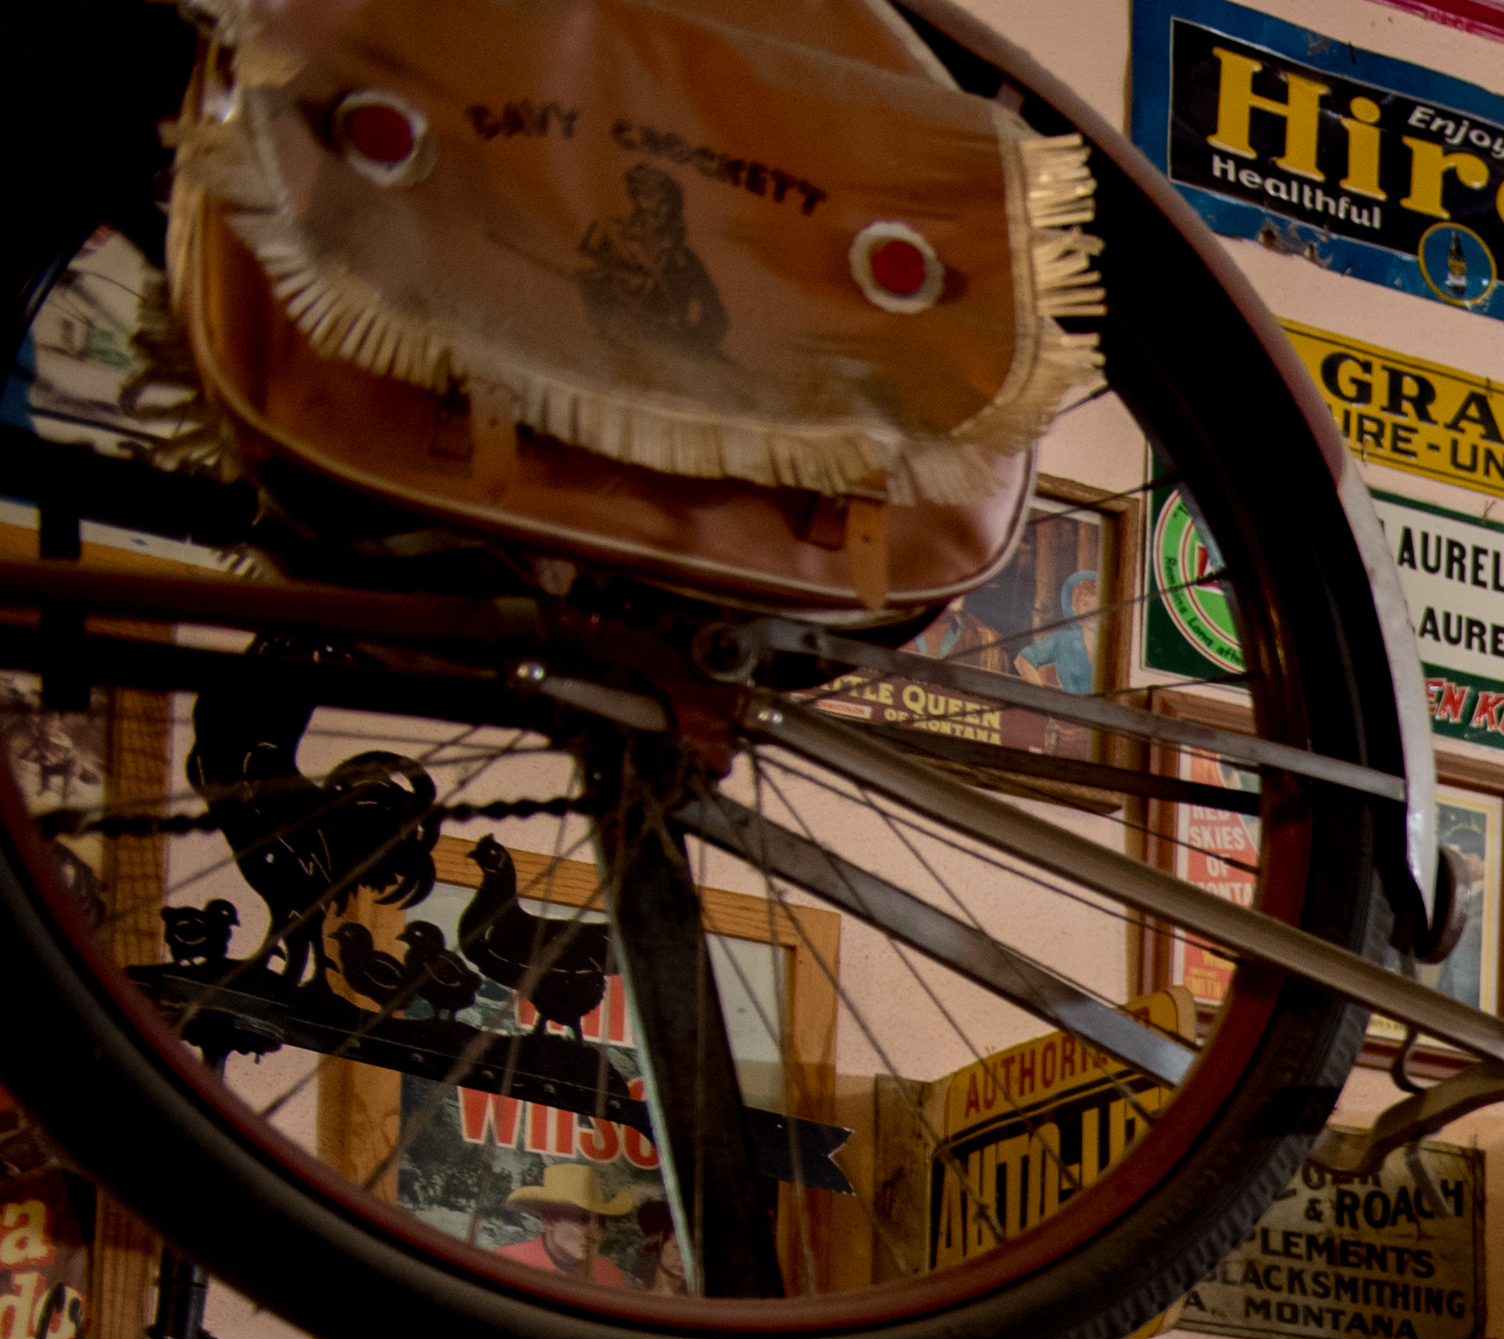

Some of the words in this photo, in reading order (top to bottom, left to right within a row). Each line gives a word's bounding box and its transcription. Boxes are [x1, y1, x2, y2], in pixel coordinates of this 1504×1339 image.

[465, 102, 580, 142] DAVY
[611, 117, 828, 217] CROCKETT
[1212, 155, 1382, 232] Healthful
[902, 684, 1000, 730] QUEEN
[1190, 826, 1245, 849] SKIES
[1206, 855, 1230, 877] OF
[1305, 1199, 1323, 1222] &
[1336, 1181, 1464, 1230] ROACH
[1261, 1228, 1434, 1278] LEMENTS
